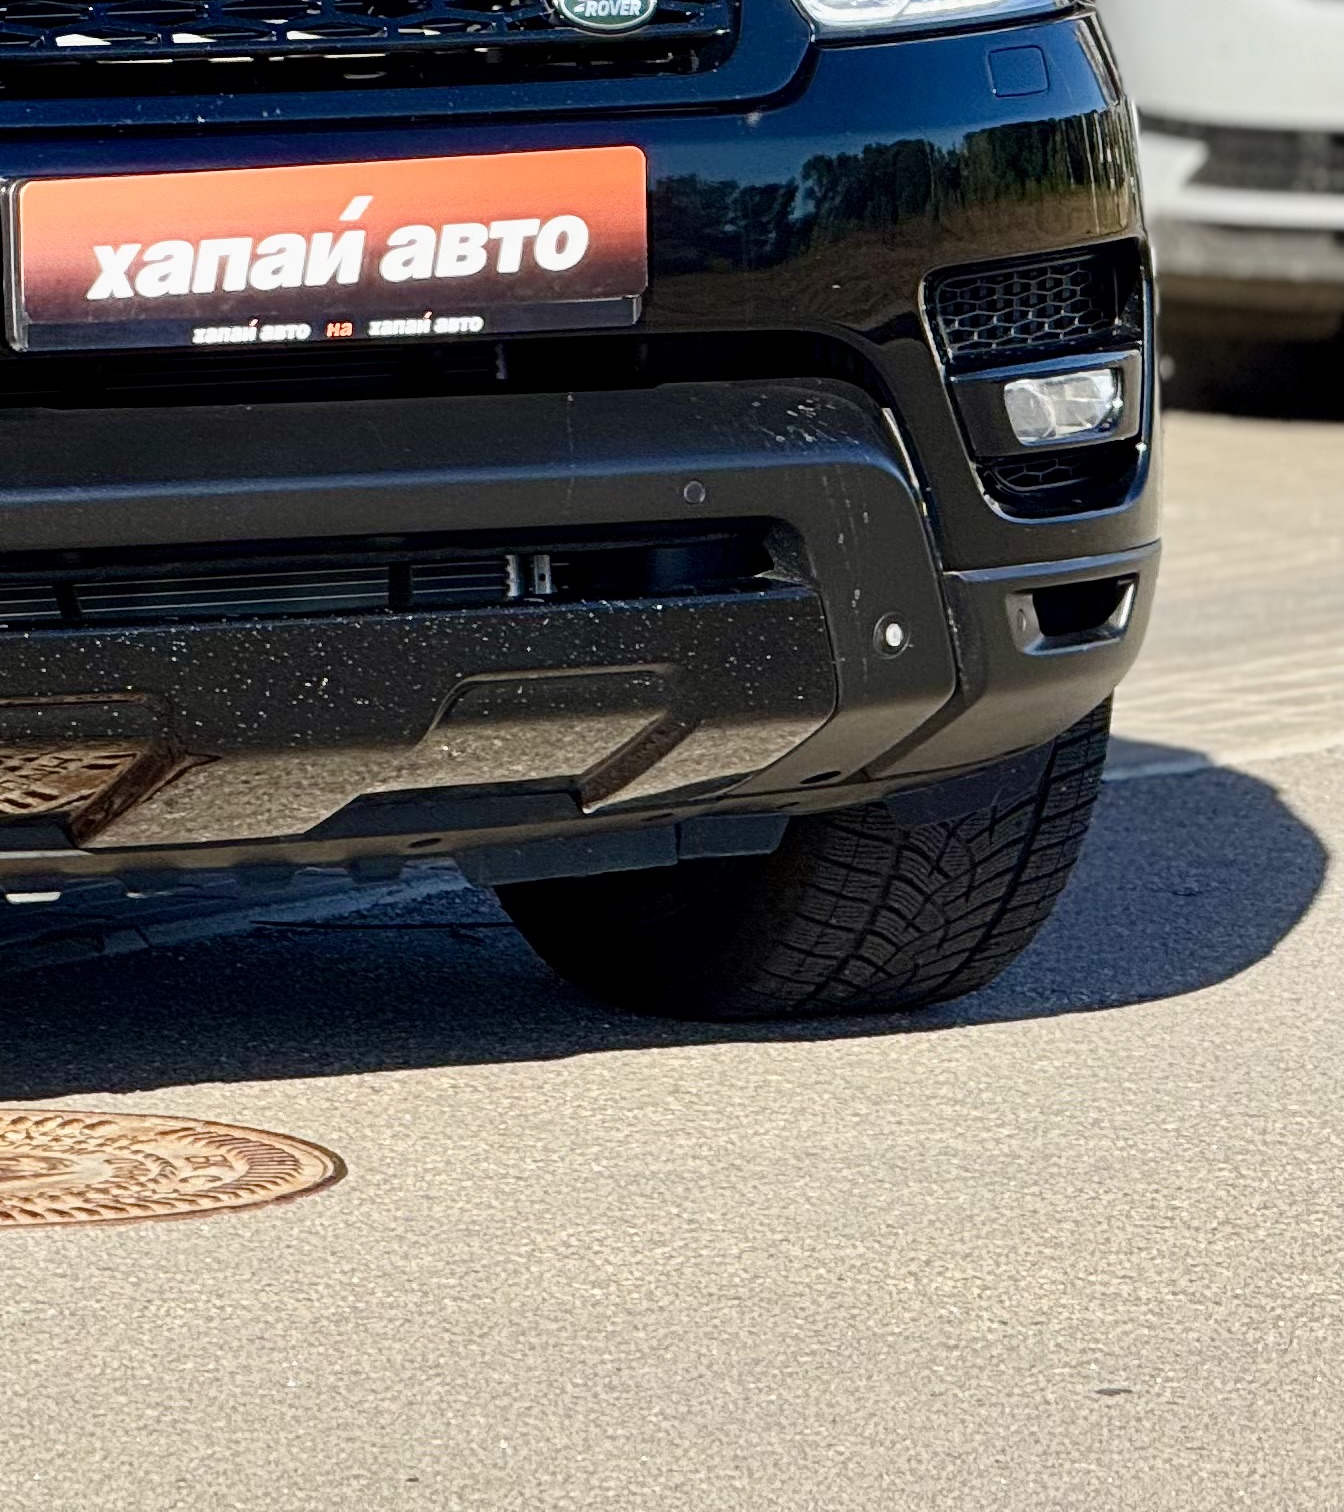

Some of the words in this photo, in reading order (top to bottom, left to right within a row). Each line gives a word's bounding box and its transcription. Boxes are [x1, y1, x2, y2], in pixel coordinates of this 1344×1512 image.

[584, 0, 642, 17] ROVER
[86, 195, 374, 301] хапай
[379, 214, 590, 282] авто
[258, 323, 312, 341] авто
[326, 322, 354, 338] на
[432, 316, 485, 333] авто
